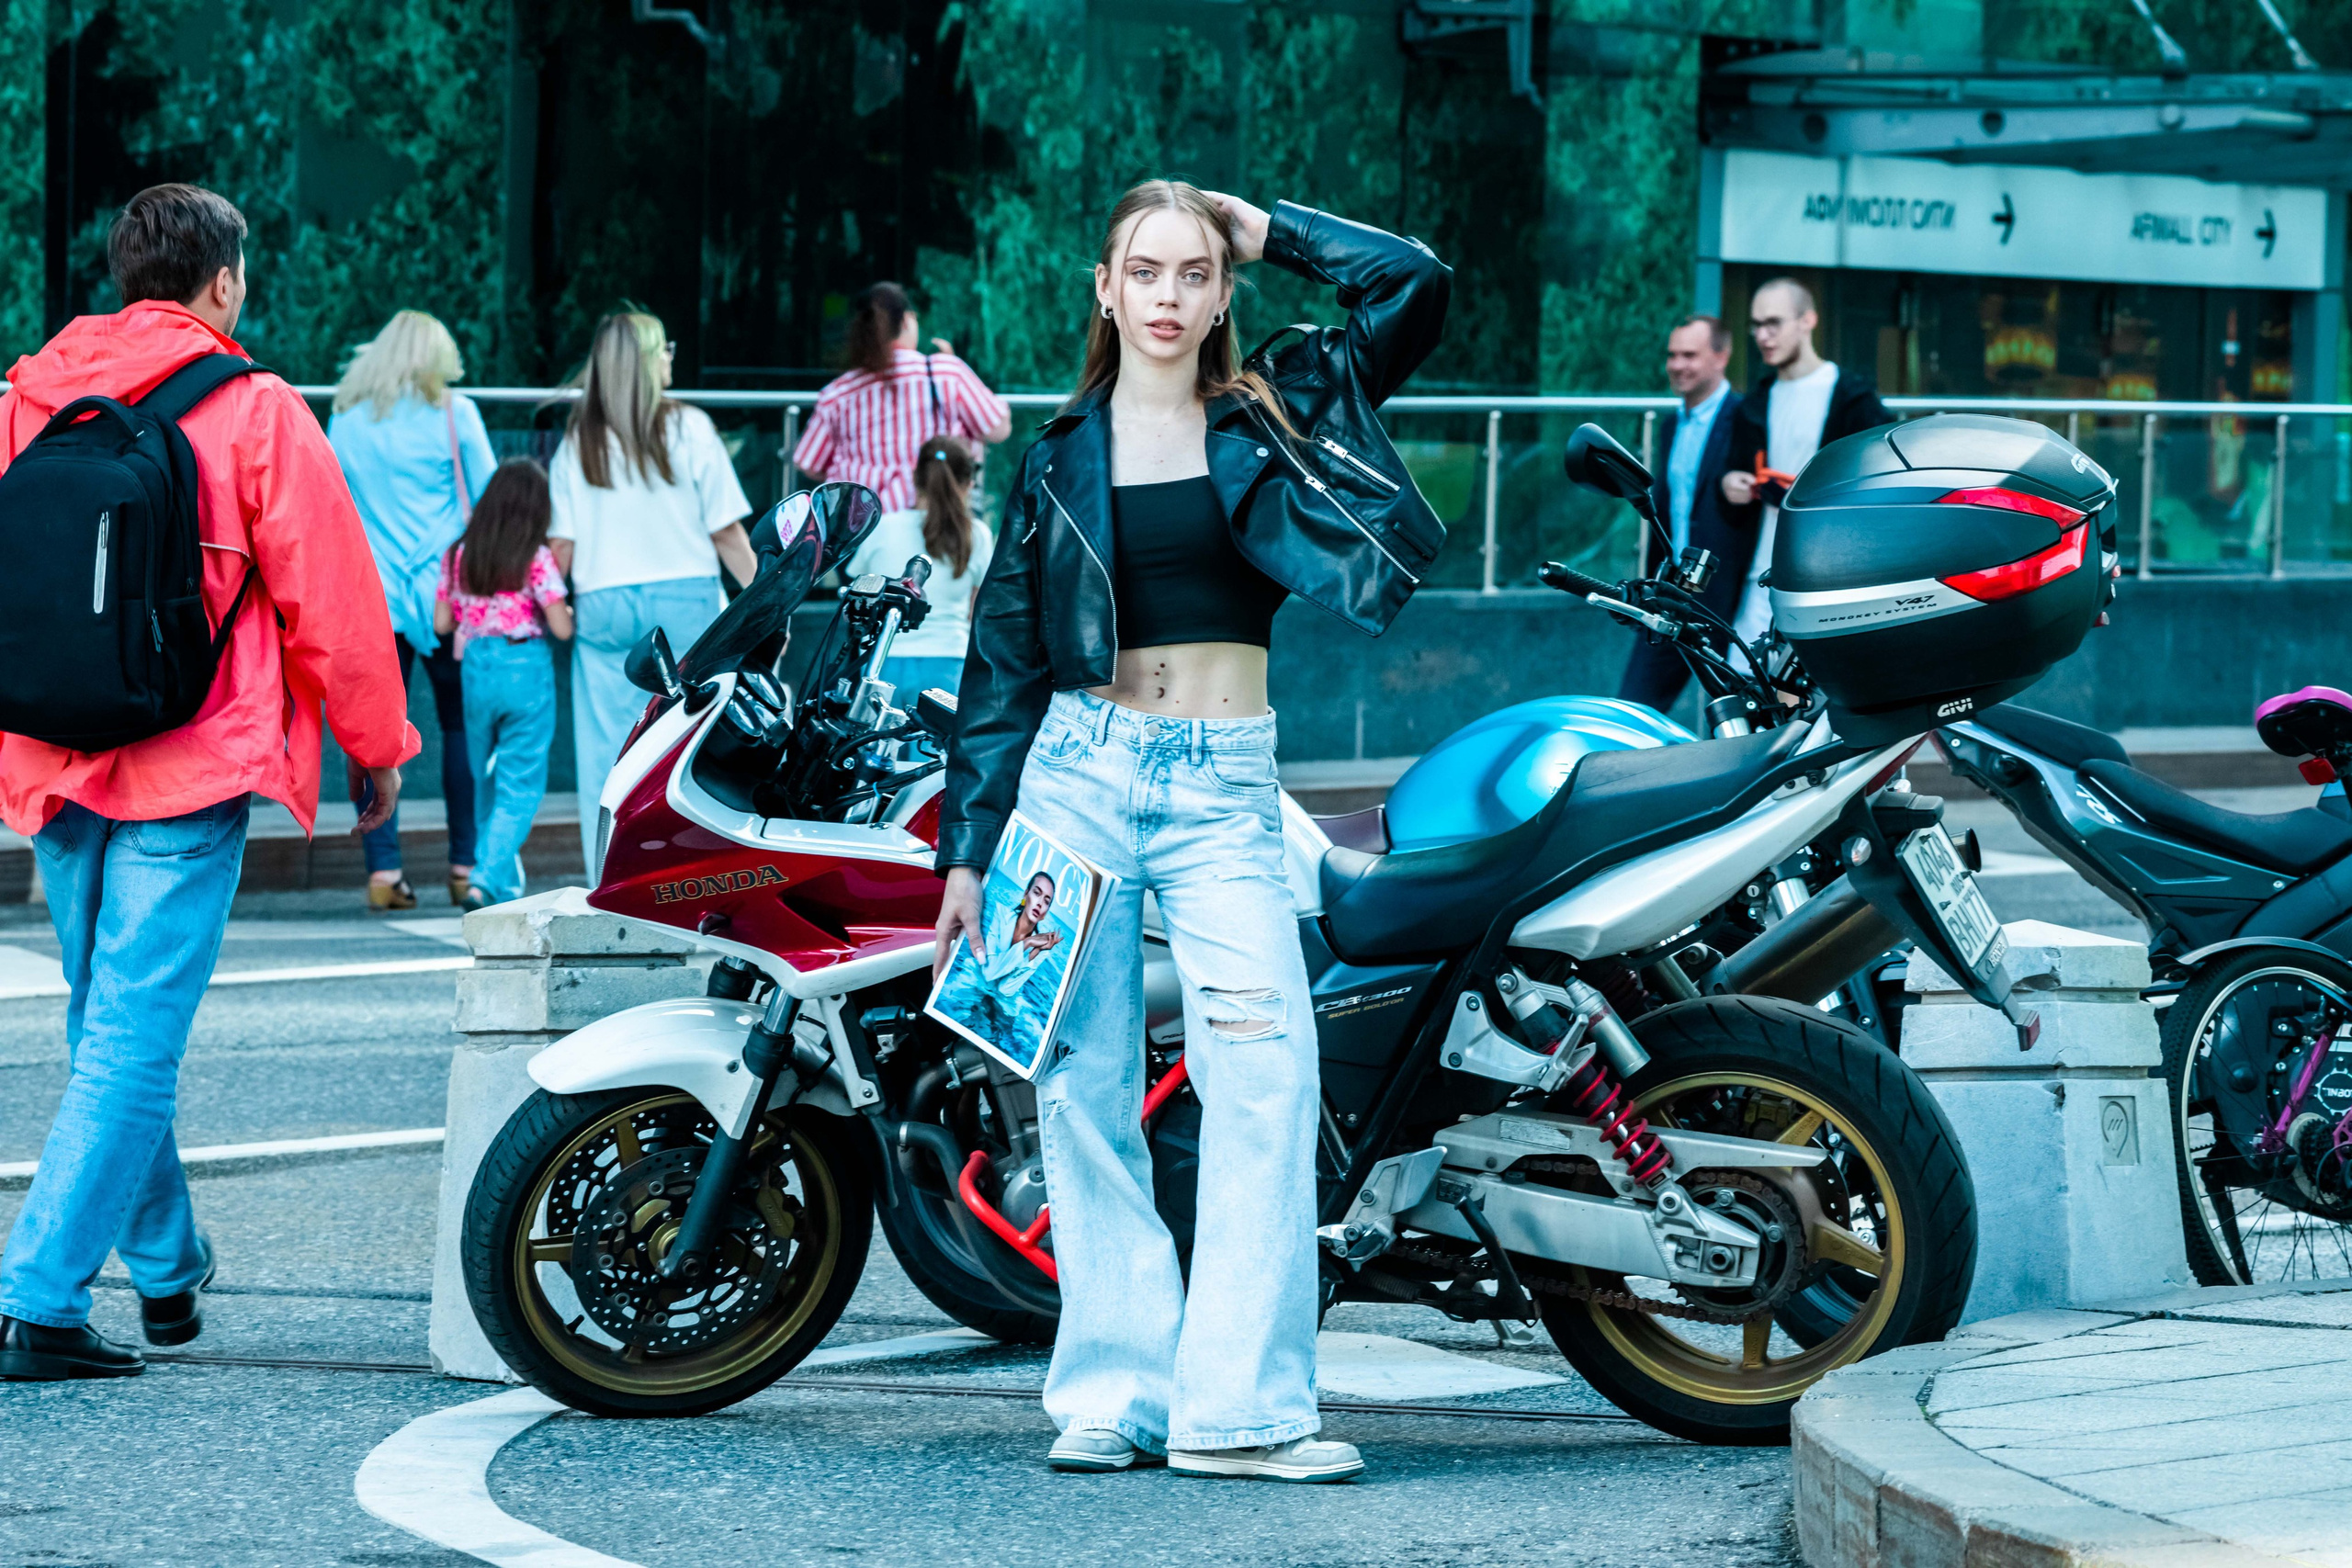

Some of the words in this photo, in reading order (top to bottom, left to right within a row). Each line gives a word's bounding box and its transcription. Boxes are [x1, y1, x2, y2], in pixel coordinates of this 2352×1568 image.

[1818, 611, 1881, 623] MONOKEY
[1885, 603, 1937, 615] SYSTEM
[1894, 594, 1935, 606] V47
[1916, 830, 1955, 892] 4048
[650, 864, 789, 904] HONDA
[1947, 903, 1983, 960] BH
[1962, 886, 1993, 936] 77
